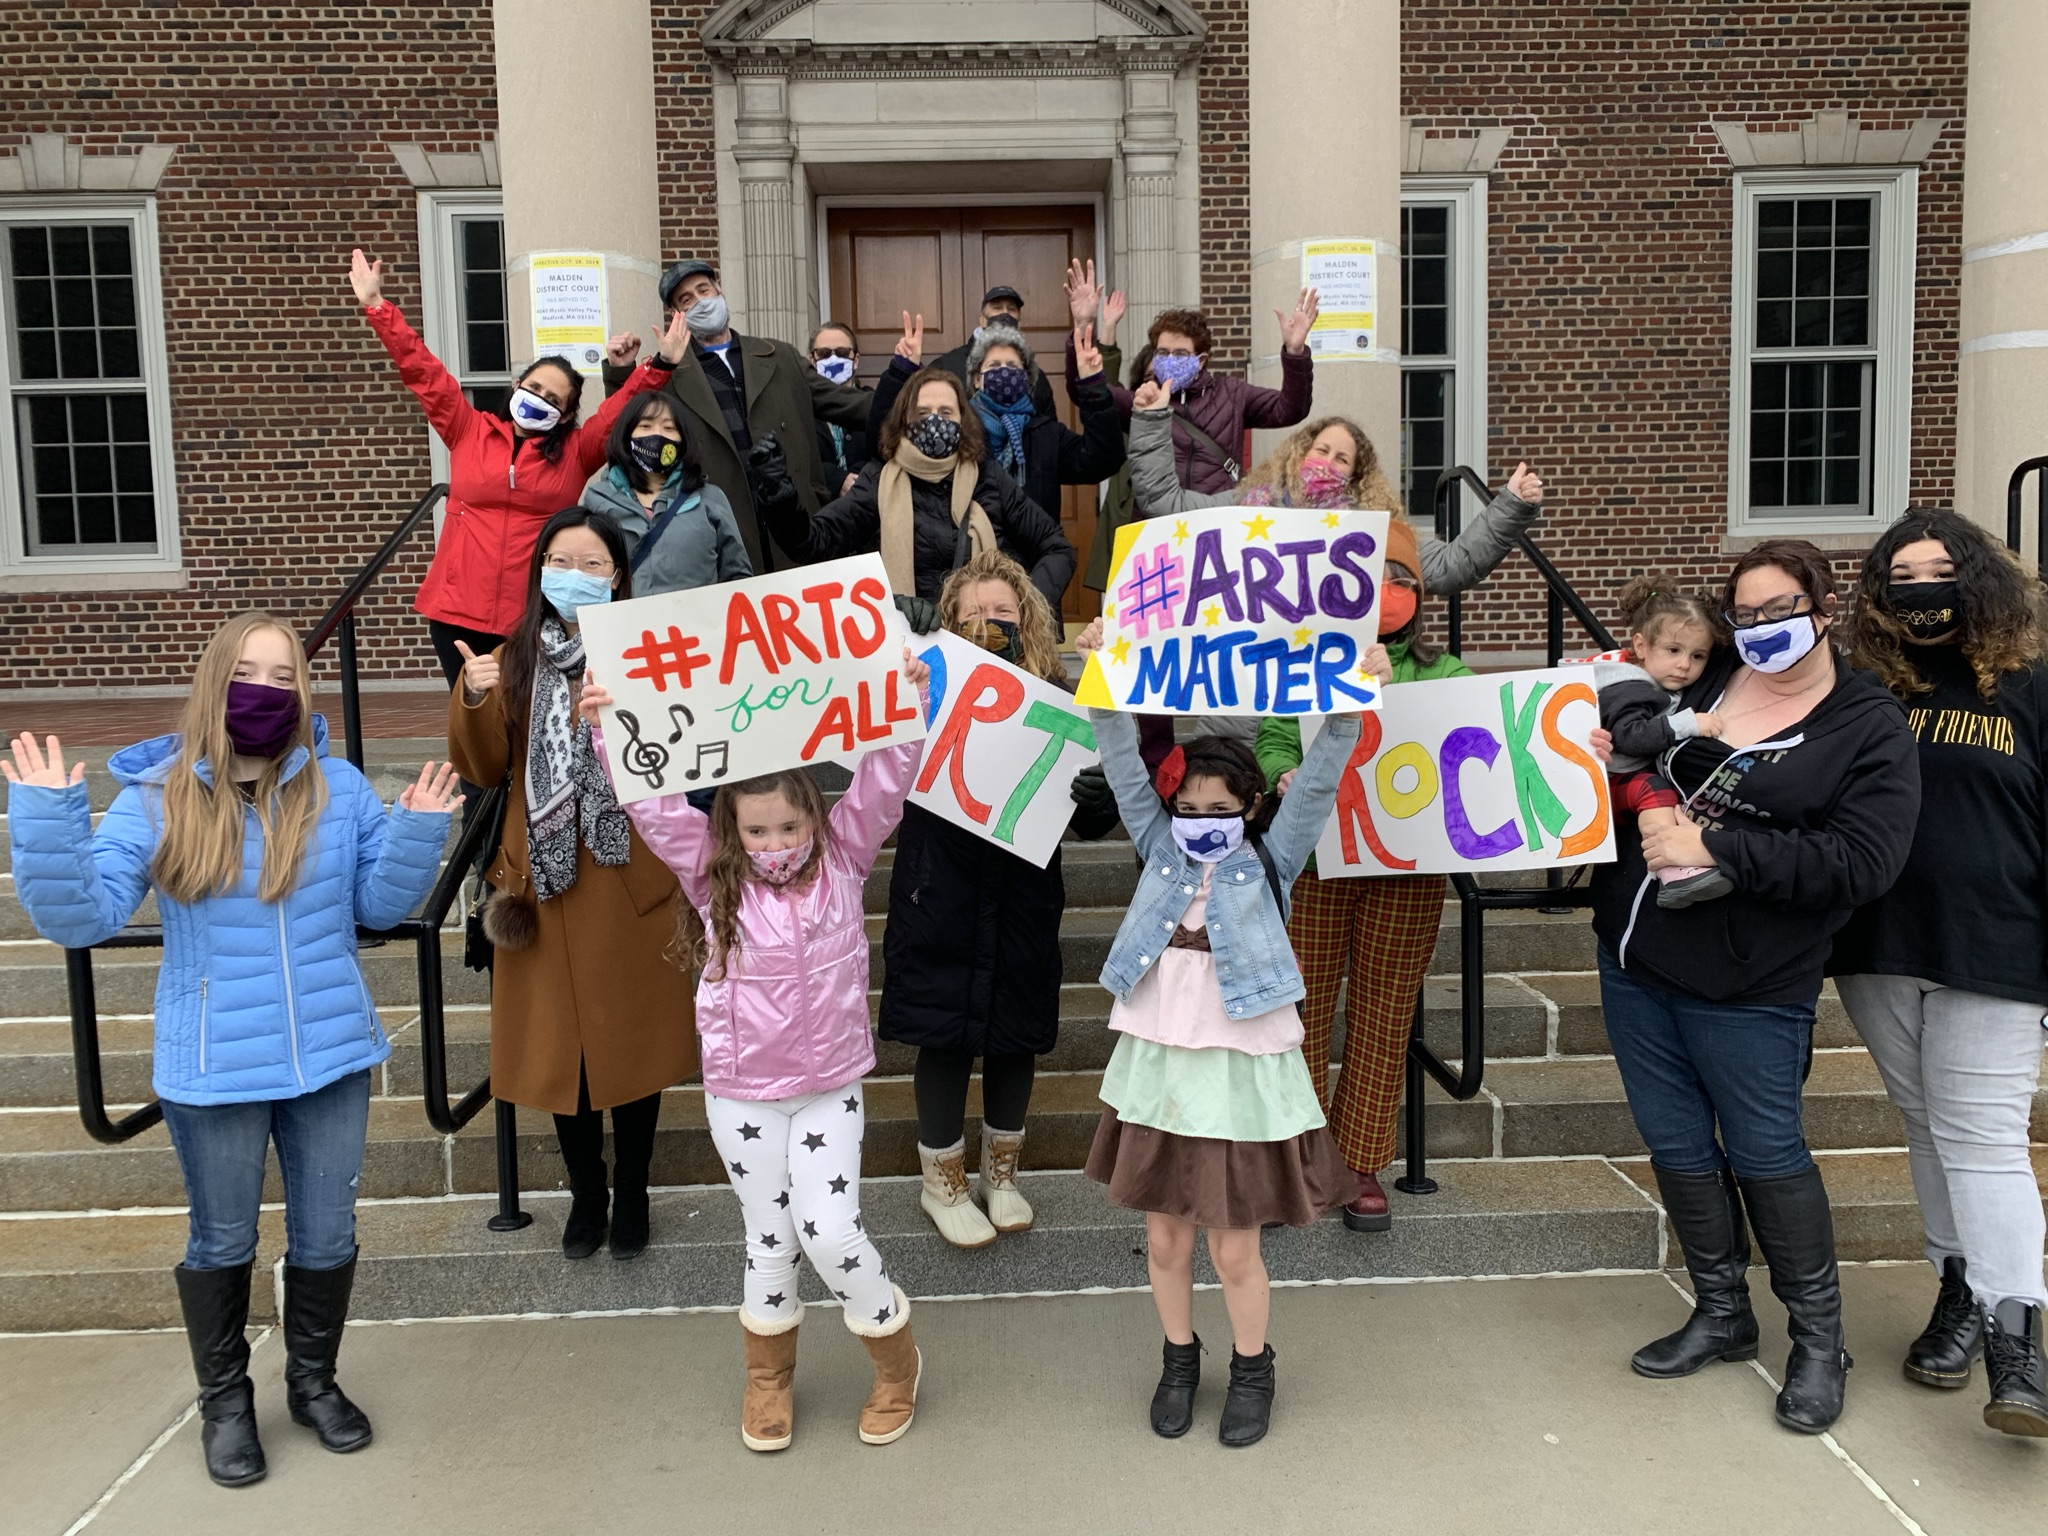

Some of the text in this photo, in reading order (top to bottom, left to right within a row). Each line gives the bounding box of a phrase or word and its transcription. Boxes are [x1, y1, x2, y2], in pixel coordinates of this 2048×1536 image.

[536, 285, 599, 294] DISTRICT COURT
[1309, 271, 1371, 280] DISTRICT COURT
[1125, 630, 1376, 714] MATTER
[714, 677, 834, 733] for
[800, 670, 918, 761] ALL
[1908, 708, 2015, 756] OF FRIENDS
[1336, 681, 1609, 871] ROCKS
[1711, 766, 1743, 792] HE
[1691, 797, 1727, 818] OU
[1703, 785, 1772, 818] HING
[1685, 809, 1724, 832] ARE
